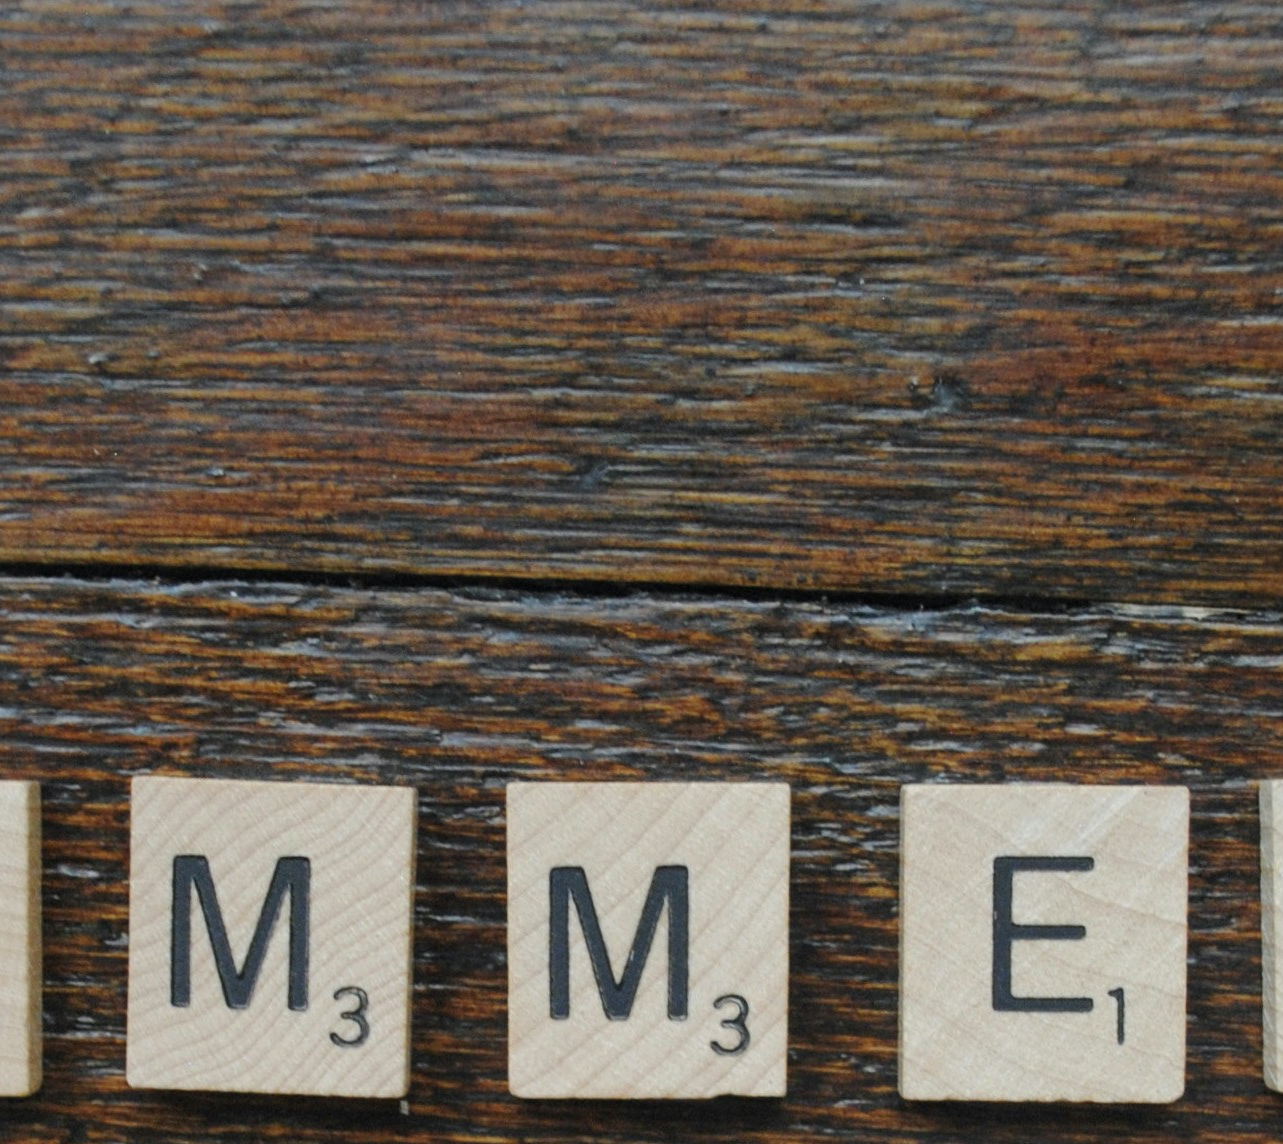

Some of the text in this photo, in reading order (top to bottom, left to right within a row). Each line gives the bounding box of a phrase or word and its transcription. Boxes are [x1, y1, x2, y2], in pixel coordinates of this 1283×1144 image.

[327, 984, 372, 1048] 3
[708, 992, 753, 1056] 3
[1105, 986, 1127, 1046] 1
